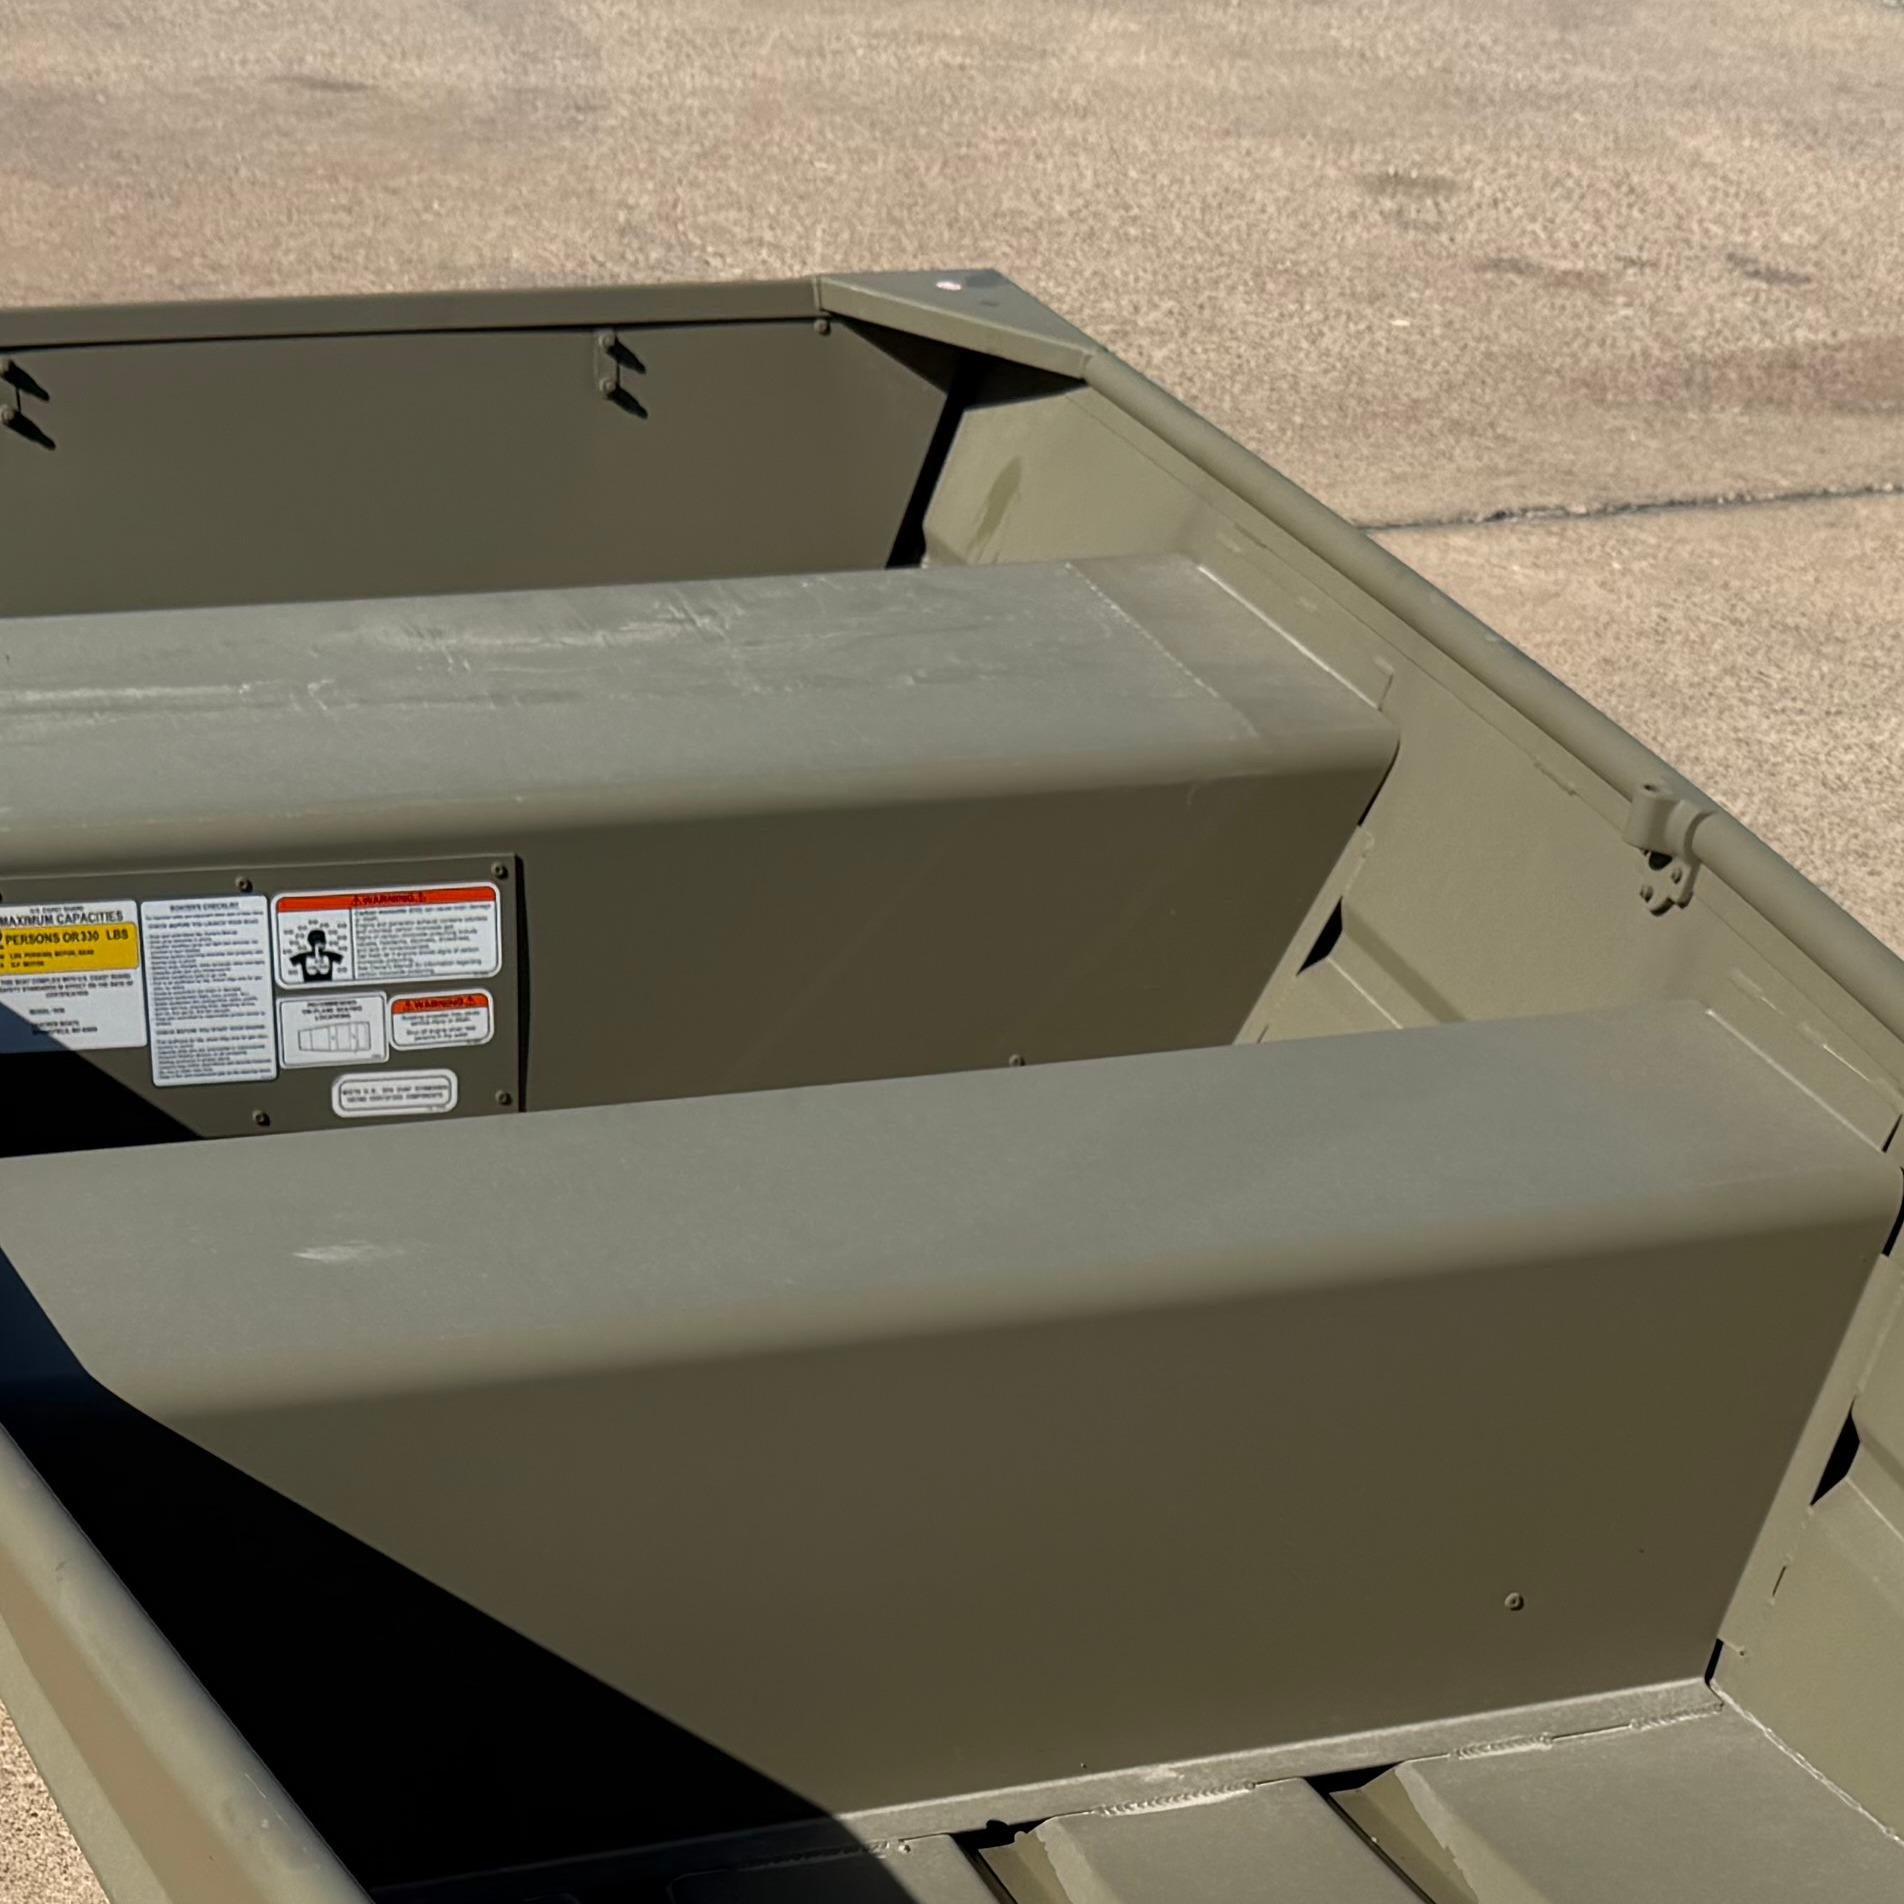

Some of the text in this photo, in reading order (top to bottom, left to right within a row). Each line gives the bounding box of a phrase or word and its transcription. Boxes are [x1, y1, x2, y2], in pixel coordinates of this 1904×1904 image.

[363, 895, 413, 905] WARNING
[0, 910, 123, 926] MAXIMUM CAPACITIES
[5, 932, 60, 945] PERSONS
[62, 931, 80, 942] OR
[81, 930, 99, 941] 330
[106, 929, 129, 940] LBS
[414, 997, 464, 1009] WARNING
